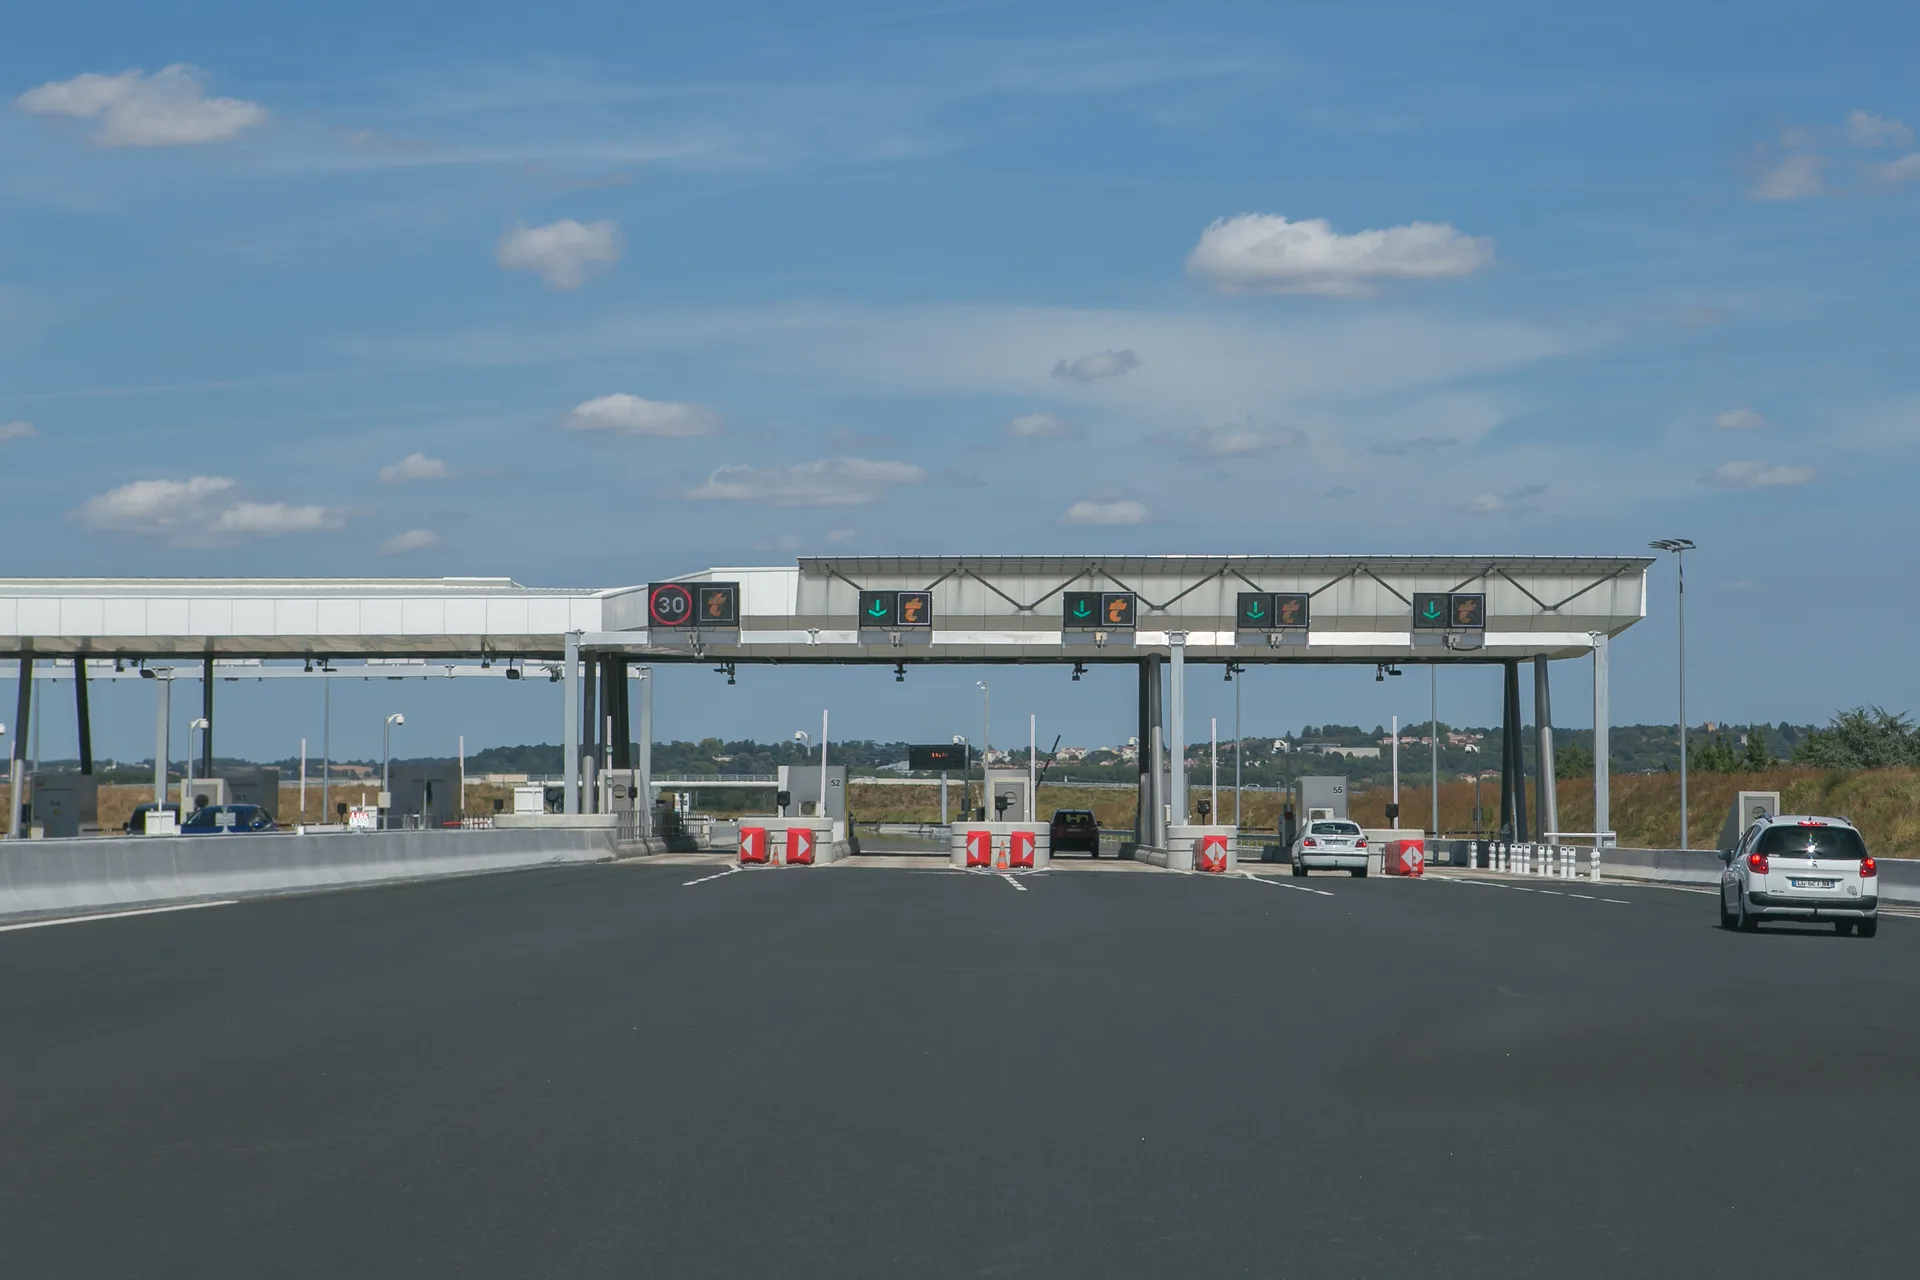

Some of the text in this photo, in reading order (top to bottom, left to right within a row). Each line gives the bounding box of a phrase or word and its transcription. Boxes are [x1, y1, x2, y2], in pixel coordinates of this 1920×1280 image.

[658, 596, 685, 614] 30
[830, 779, 841, 787] 52
[1332, 786, 1343, 794] 55
